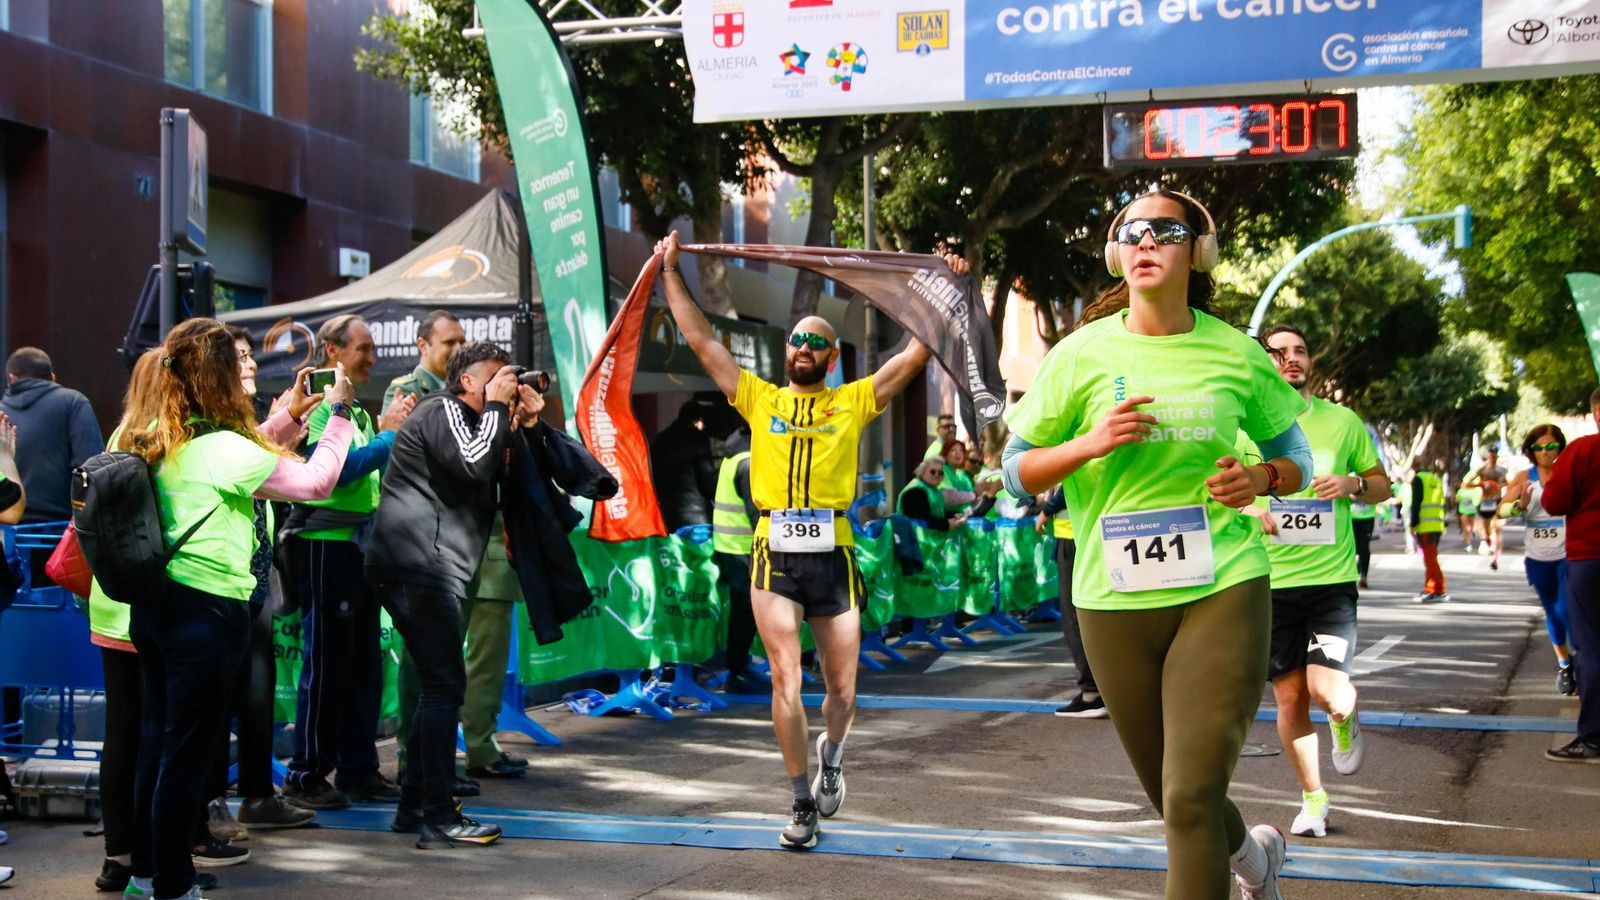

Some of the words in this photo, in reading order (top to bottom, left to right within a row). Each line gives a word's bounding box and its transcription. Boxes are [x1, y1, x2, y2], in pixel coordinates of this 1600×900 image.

[902, 14, 943, 31] SOLAN
[996, 0, 1144, 36] contra
[1557, 15, 1600, 28] Toyot
[1362, 29, 1419, 43] asociación
[1420, 26, 1468, 40] española
[1364, 44, 1399, 55] contra
[1401, 42, 1408, 53] el
[1410, 40, 1447, 52] cáncer
[697, 56, 758, 72] ALMERÍA
[1364, 56, 1379, 66] en
[983, 66, 1132, 85] #TodosContraElCáncer
[1198, 404, 1216, 419] el
[1144, 425, 1216, 443] ancer
[1136, 522, 1160, 530] cáncer
[1281, 513, 1322, 530] 264
[782, 523, 821, 538] 398
[1533, 528, 1558, 539] 835
[1124, 533, 1186, 566] 141
